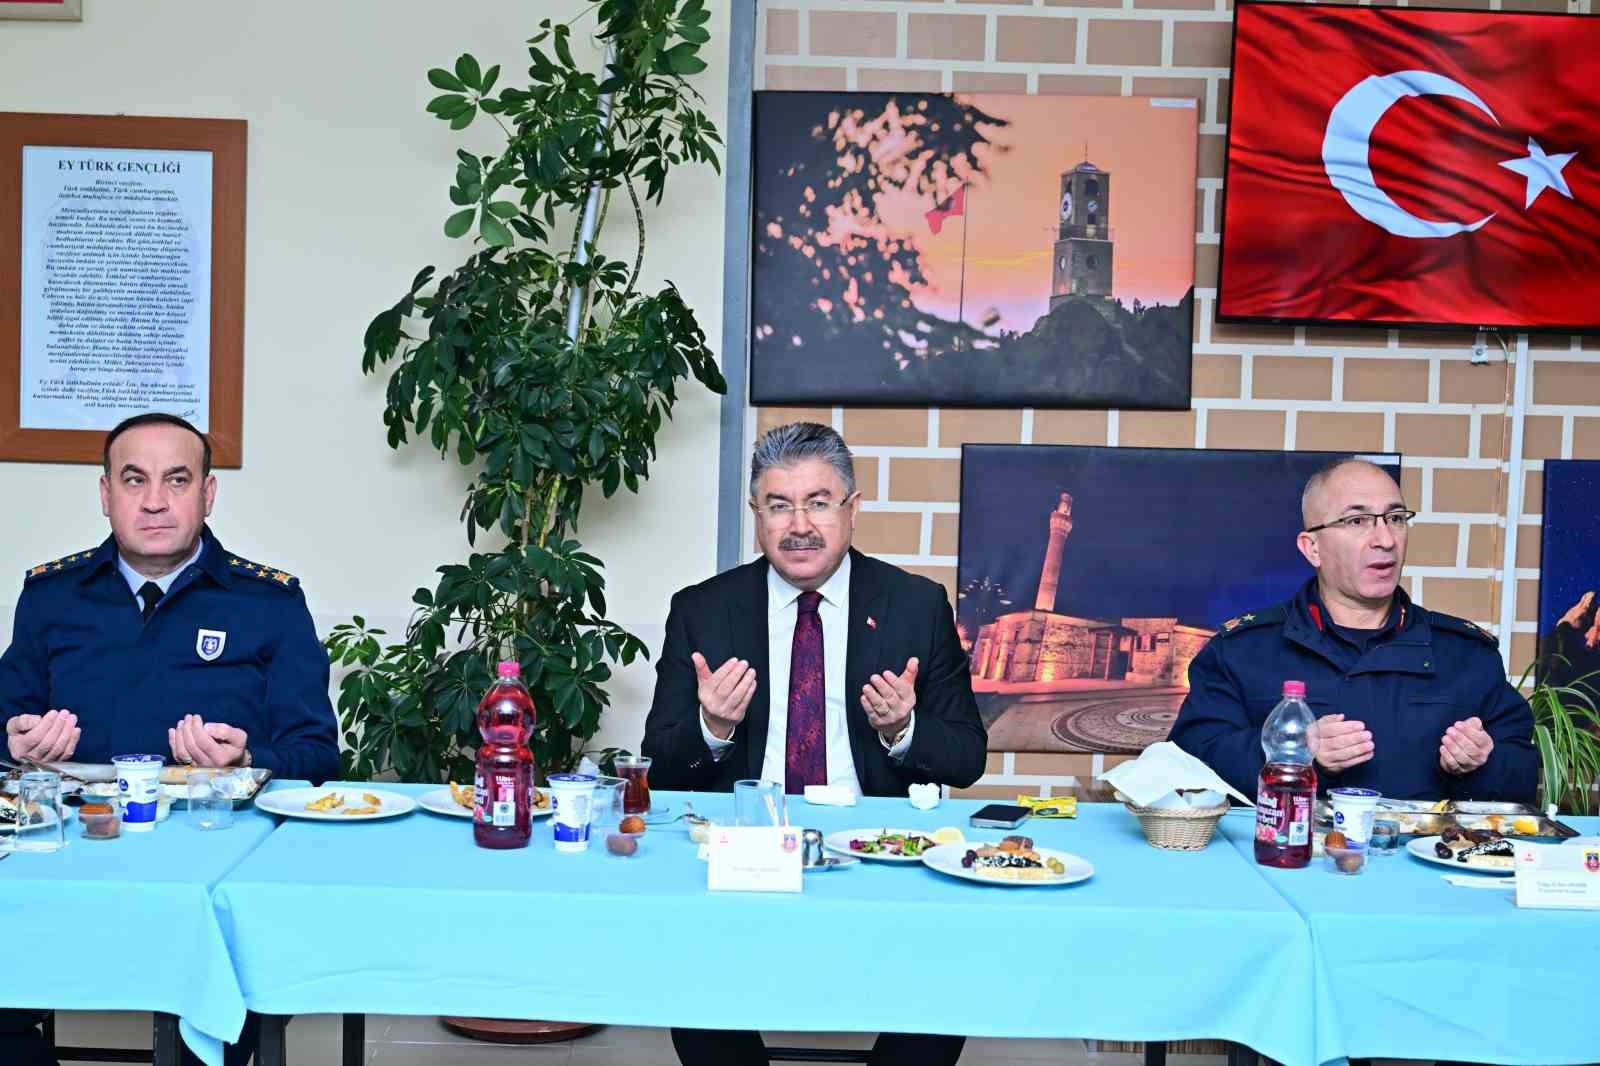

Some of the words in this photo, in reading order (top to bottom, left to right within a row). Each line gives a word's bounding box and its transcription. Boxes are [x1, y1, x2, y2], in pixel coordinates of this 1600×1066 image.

[58, 160, 73, 170] EY
[79, 159, 113, 171] TÜRK
[117, 160, 181, 174] GENÇLİĞİ
